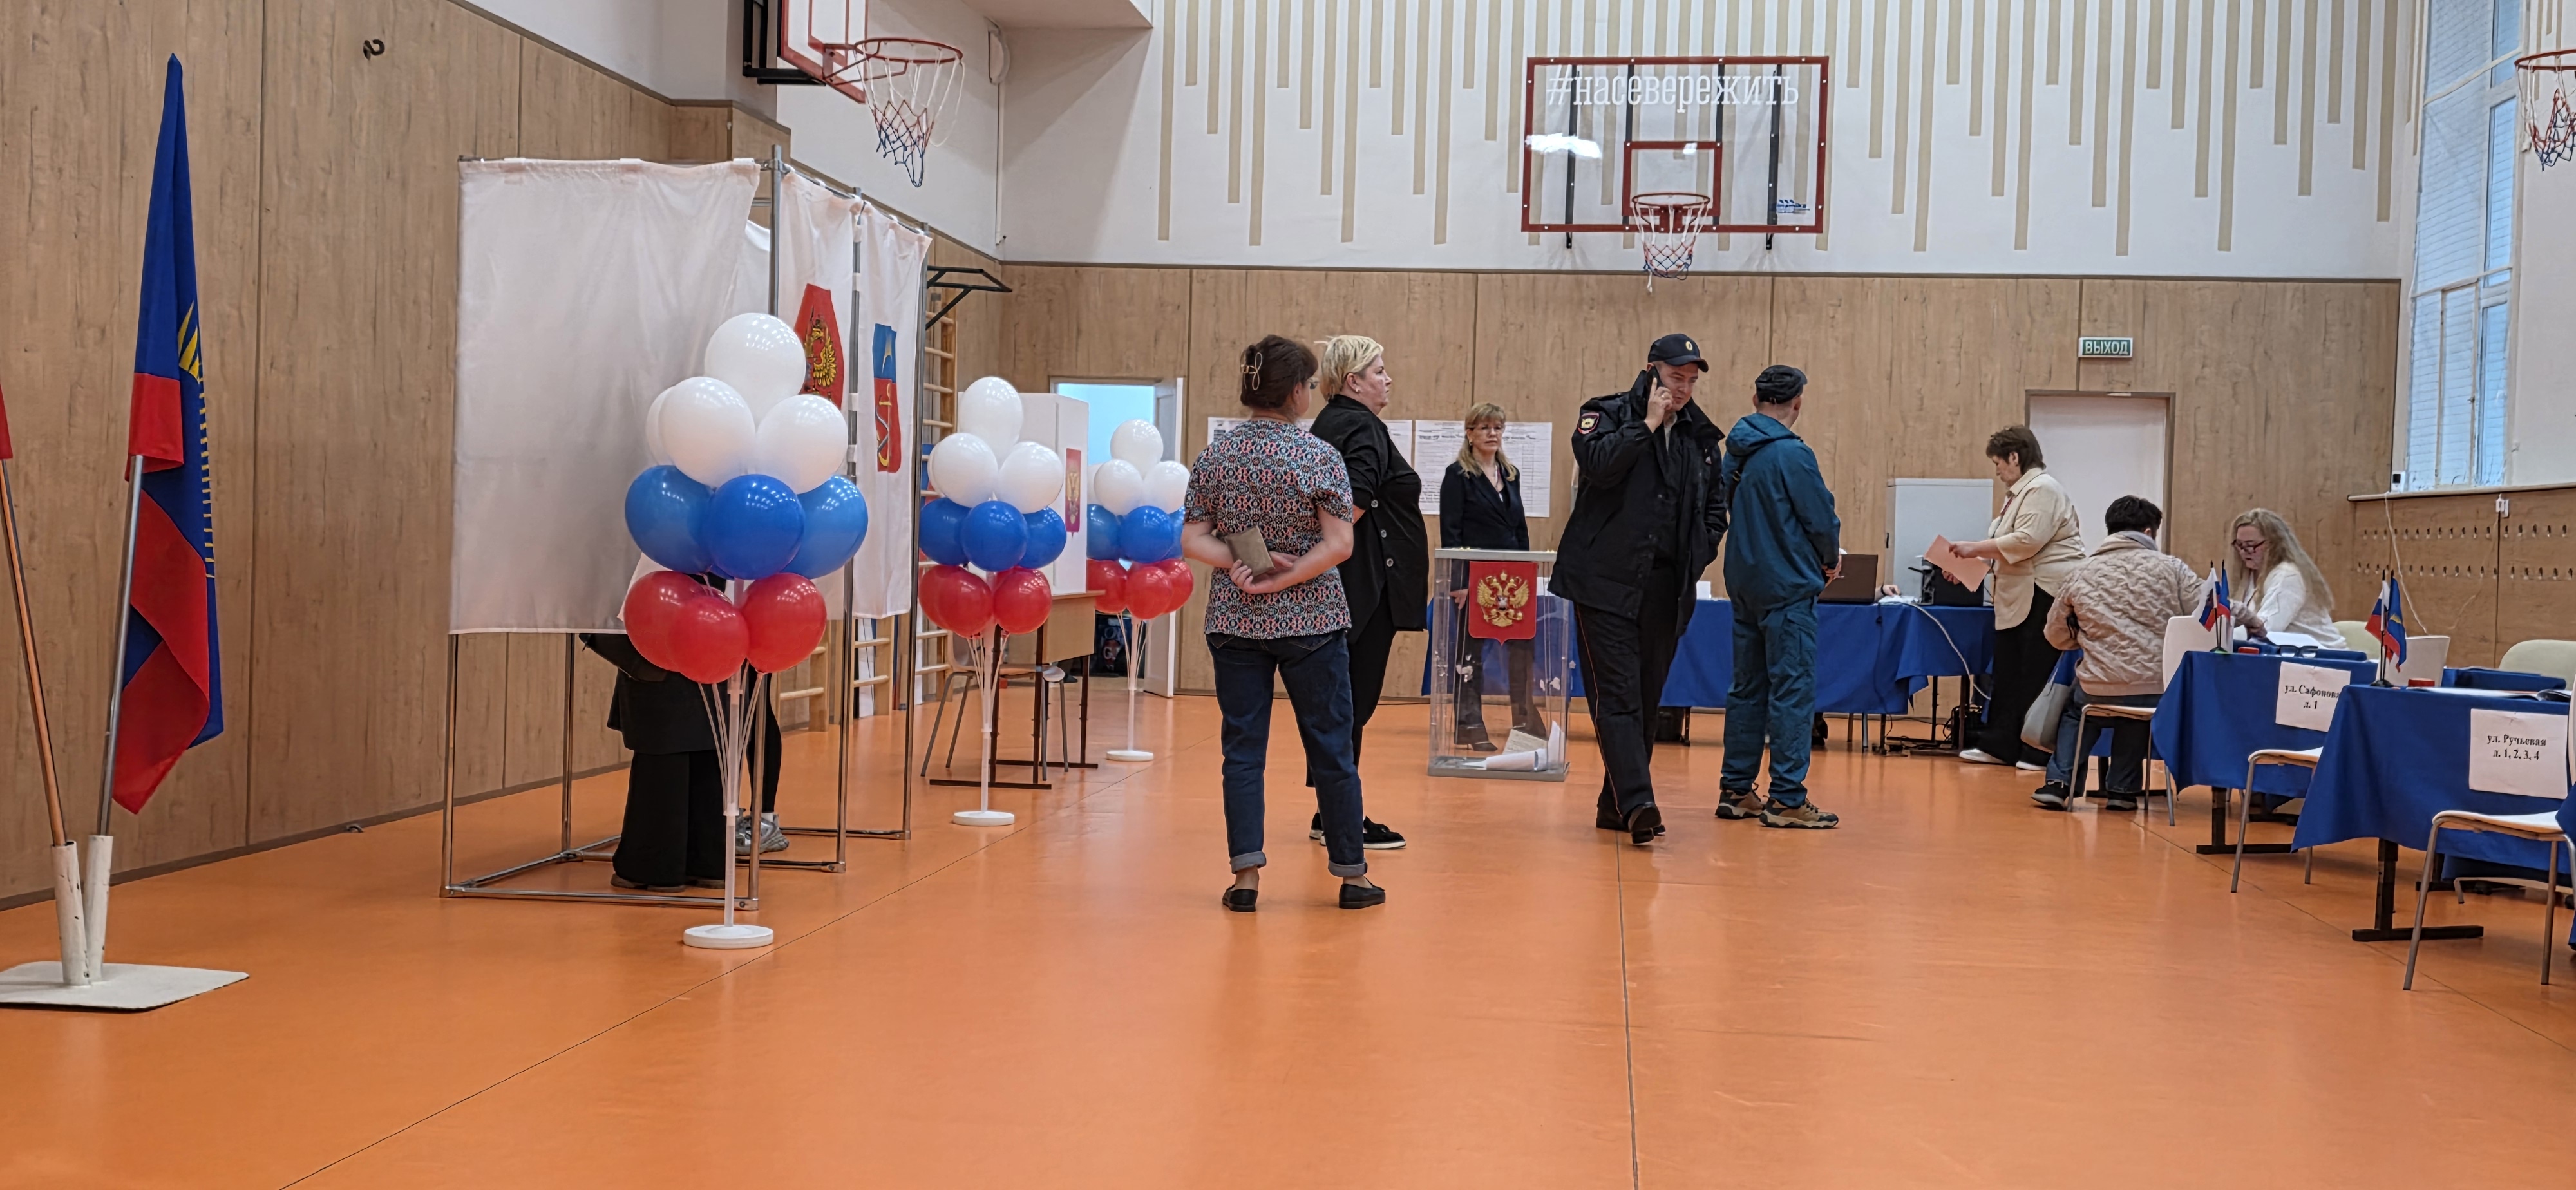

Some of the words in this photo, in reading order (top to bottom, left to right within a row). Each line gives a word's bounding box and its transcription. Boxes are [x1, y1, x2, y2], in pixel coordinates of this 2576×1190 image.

[1546, 64, 1799, 113] #насевережить
[2085, 340, 2128, 355] ВЫХОД
[2284, 685, 2297, 694] ул.
[2314, 700, 2318, 710] 1
[2487, 735, 2501, 745] ул.
[2503, 734, 2546, 746] Ручьевая
[2533, 750, 2539, 760] 4
